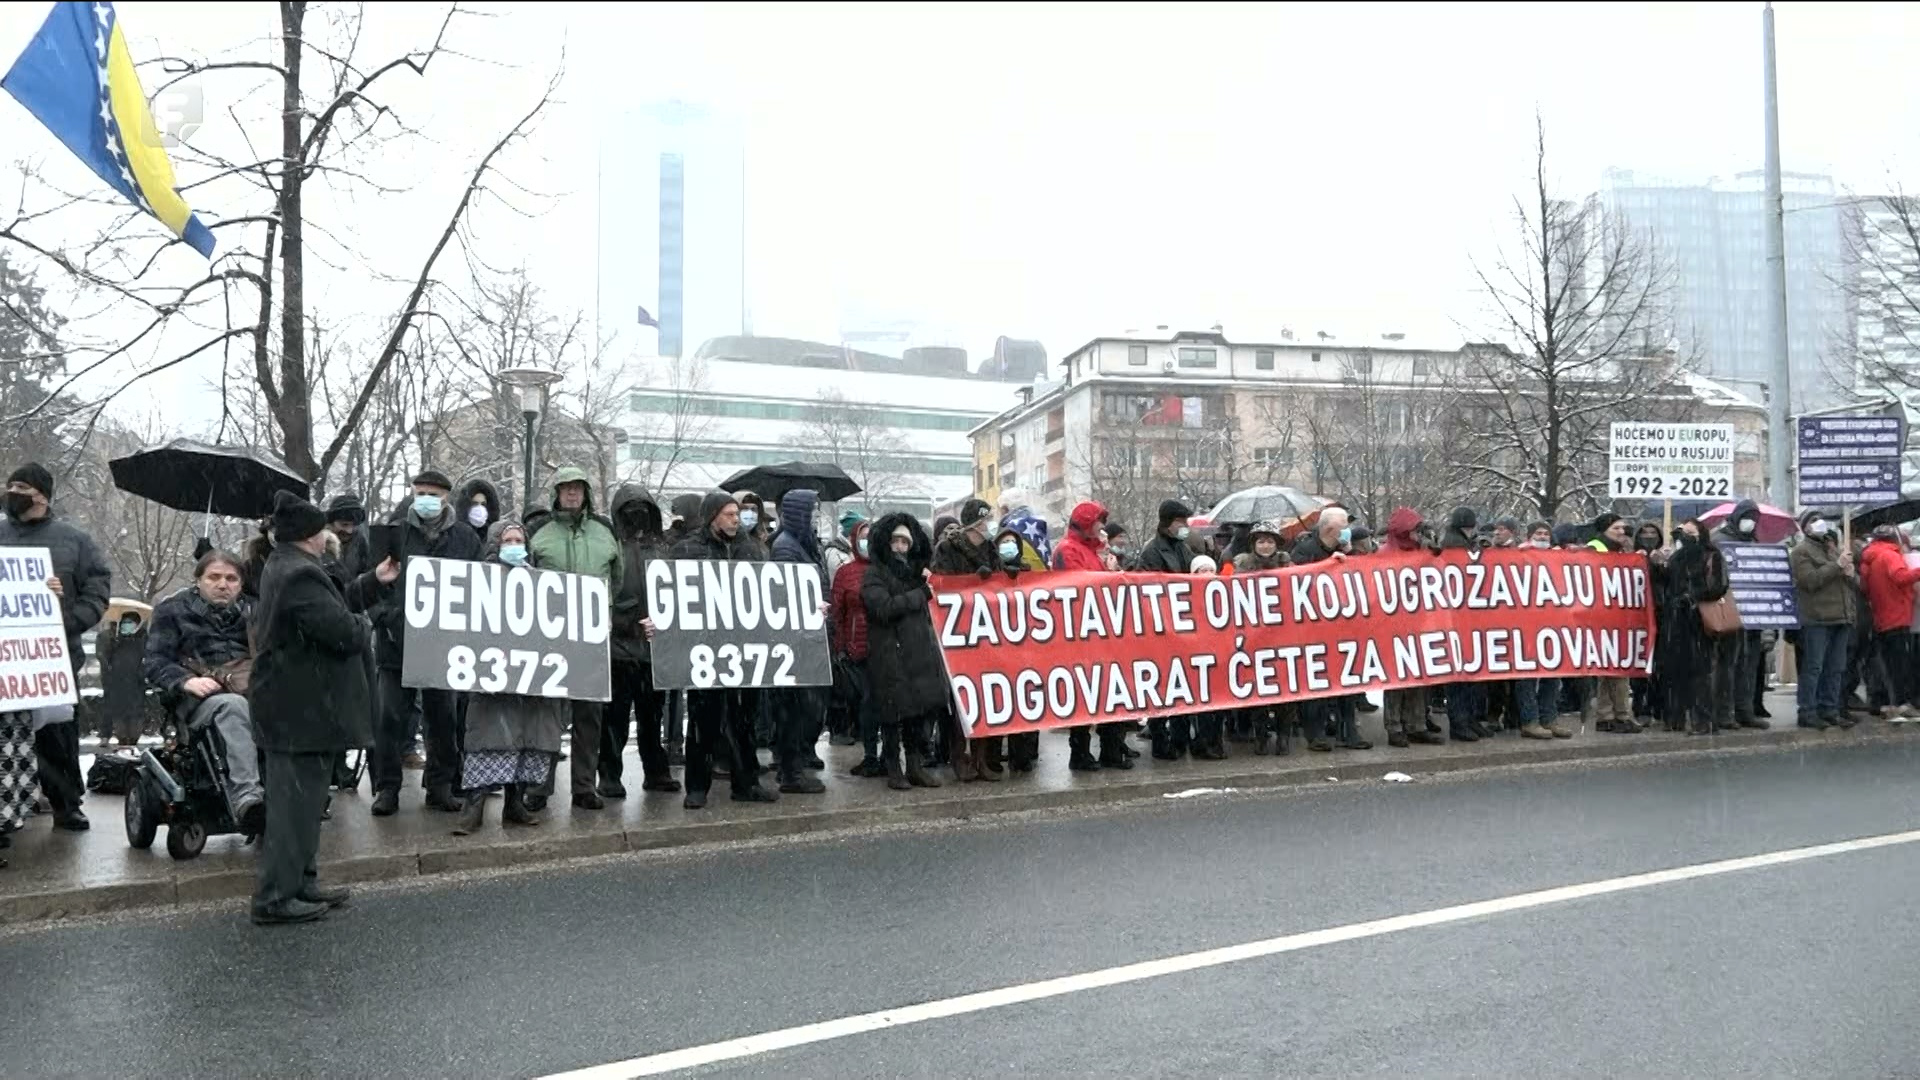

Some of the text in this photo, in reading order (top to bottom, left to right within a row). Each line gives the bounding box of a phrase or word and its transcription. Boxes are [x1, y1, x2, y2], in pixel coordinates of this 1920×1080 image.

[1668, 429, 1675, 440] U
[1679, 429, 1730, 443] EUROPU,
[1669, 447, 1677, 458] U
[1614, 477, 1663, 494] 1992
[1686, 465, 1704, 474] ARE
[25, 557, 46, 582] EU
[404, 557, 609, 644] GENOCID
[646, 560, 825, 631] GENOCID
[937, 552, 1645, 647] ZAUSTAVITE ONE KOJI UGROŽAVAJU MIR
[446, 645, 568, 698] 8372
[689, 643, 796, 688] 8372
[951, 627, 1647, 728] ODGOVARAT ĆETE ZA NEDJELOVANJE
